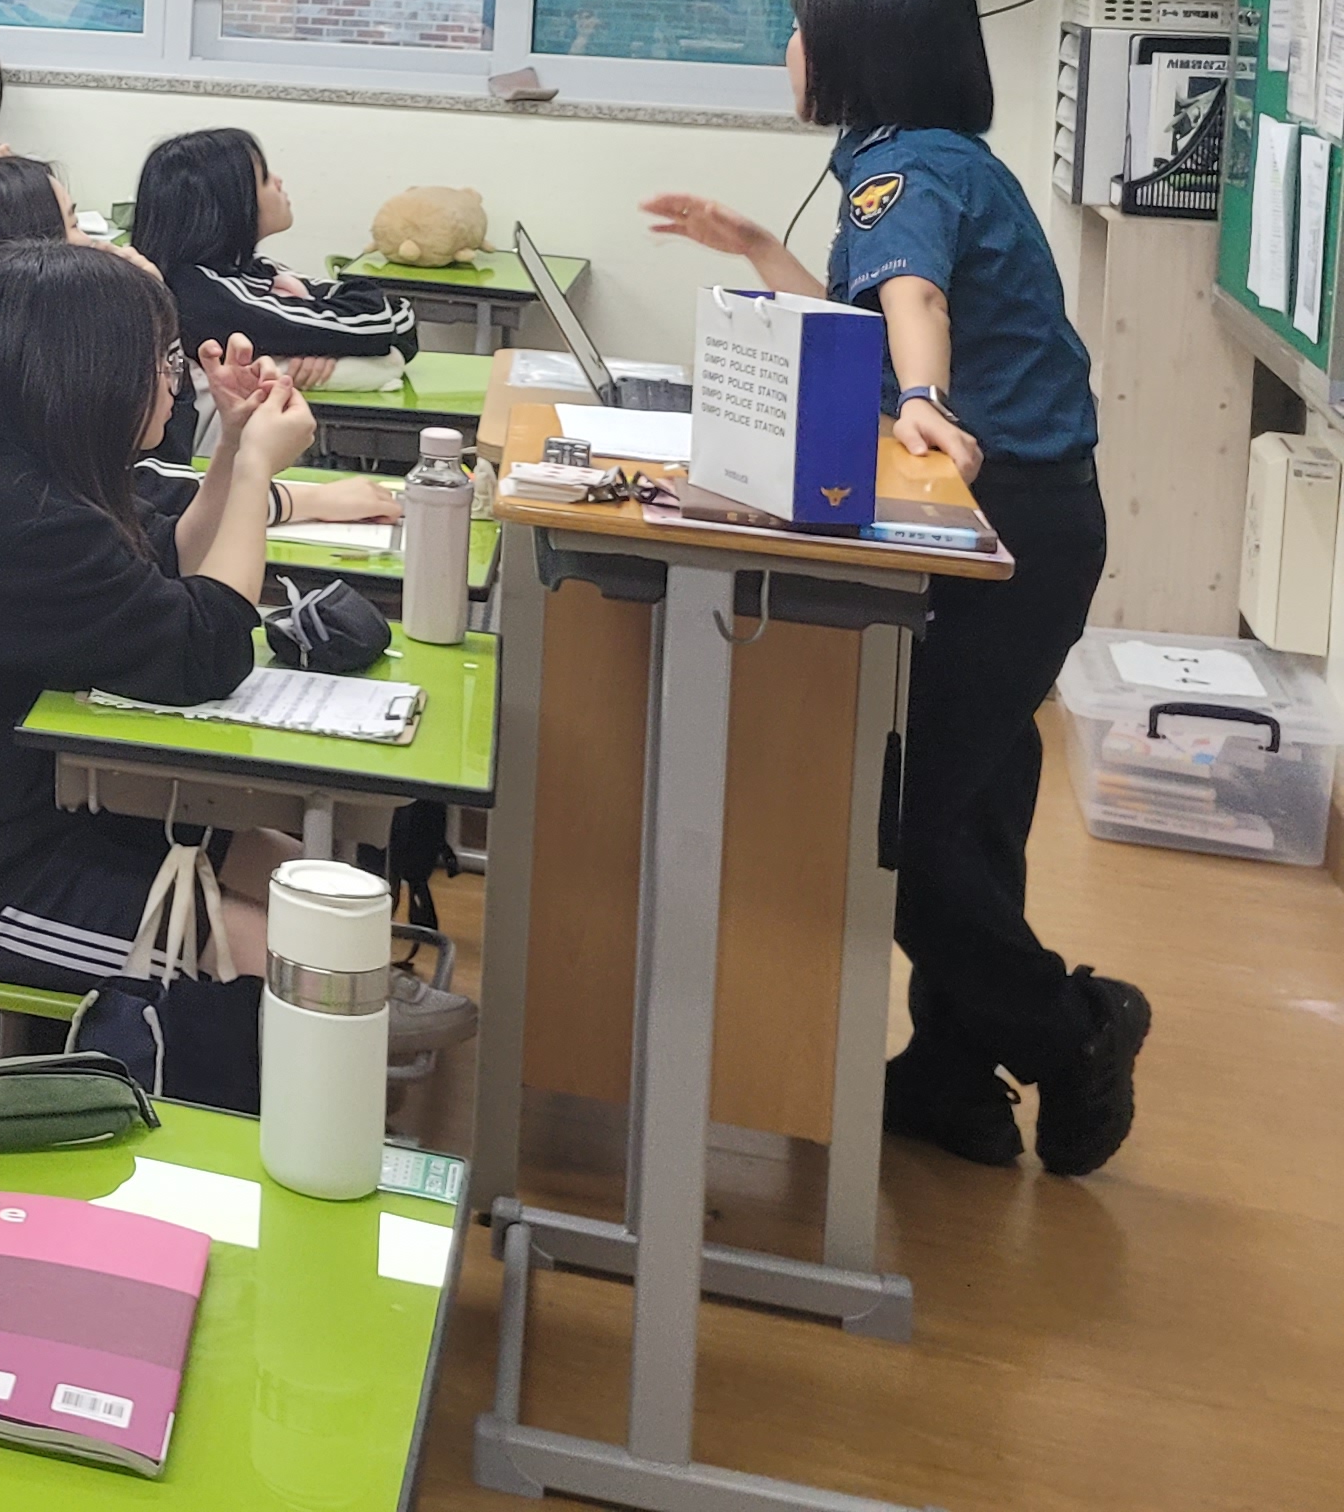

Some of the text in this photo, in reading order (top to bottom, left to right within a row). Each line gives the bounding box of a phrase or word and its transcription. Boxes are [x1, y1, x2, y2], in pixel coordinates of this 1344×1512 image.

[704, 353, 788, 385] GIMPO POLICE STATION
[706, 336, 789, 368] GIMPO POLICE STATION
[701, 386, 786, 420] GIMPO POLICE STATION
[702, 369, 787, 403] GIMPO POLICE STATION
[701, 402, 785, 437] GIMPO POLICE STATION
